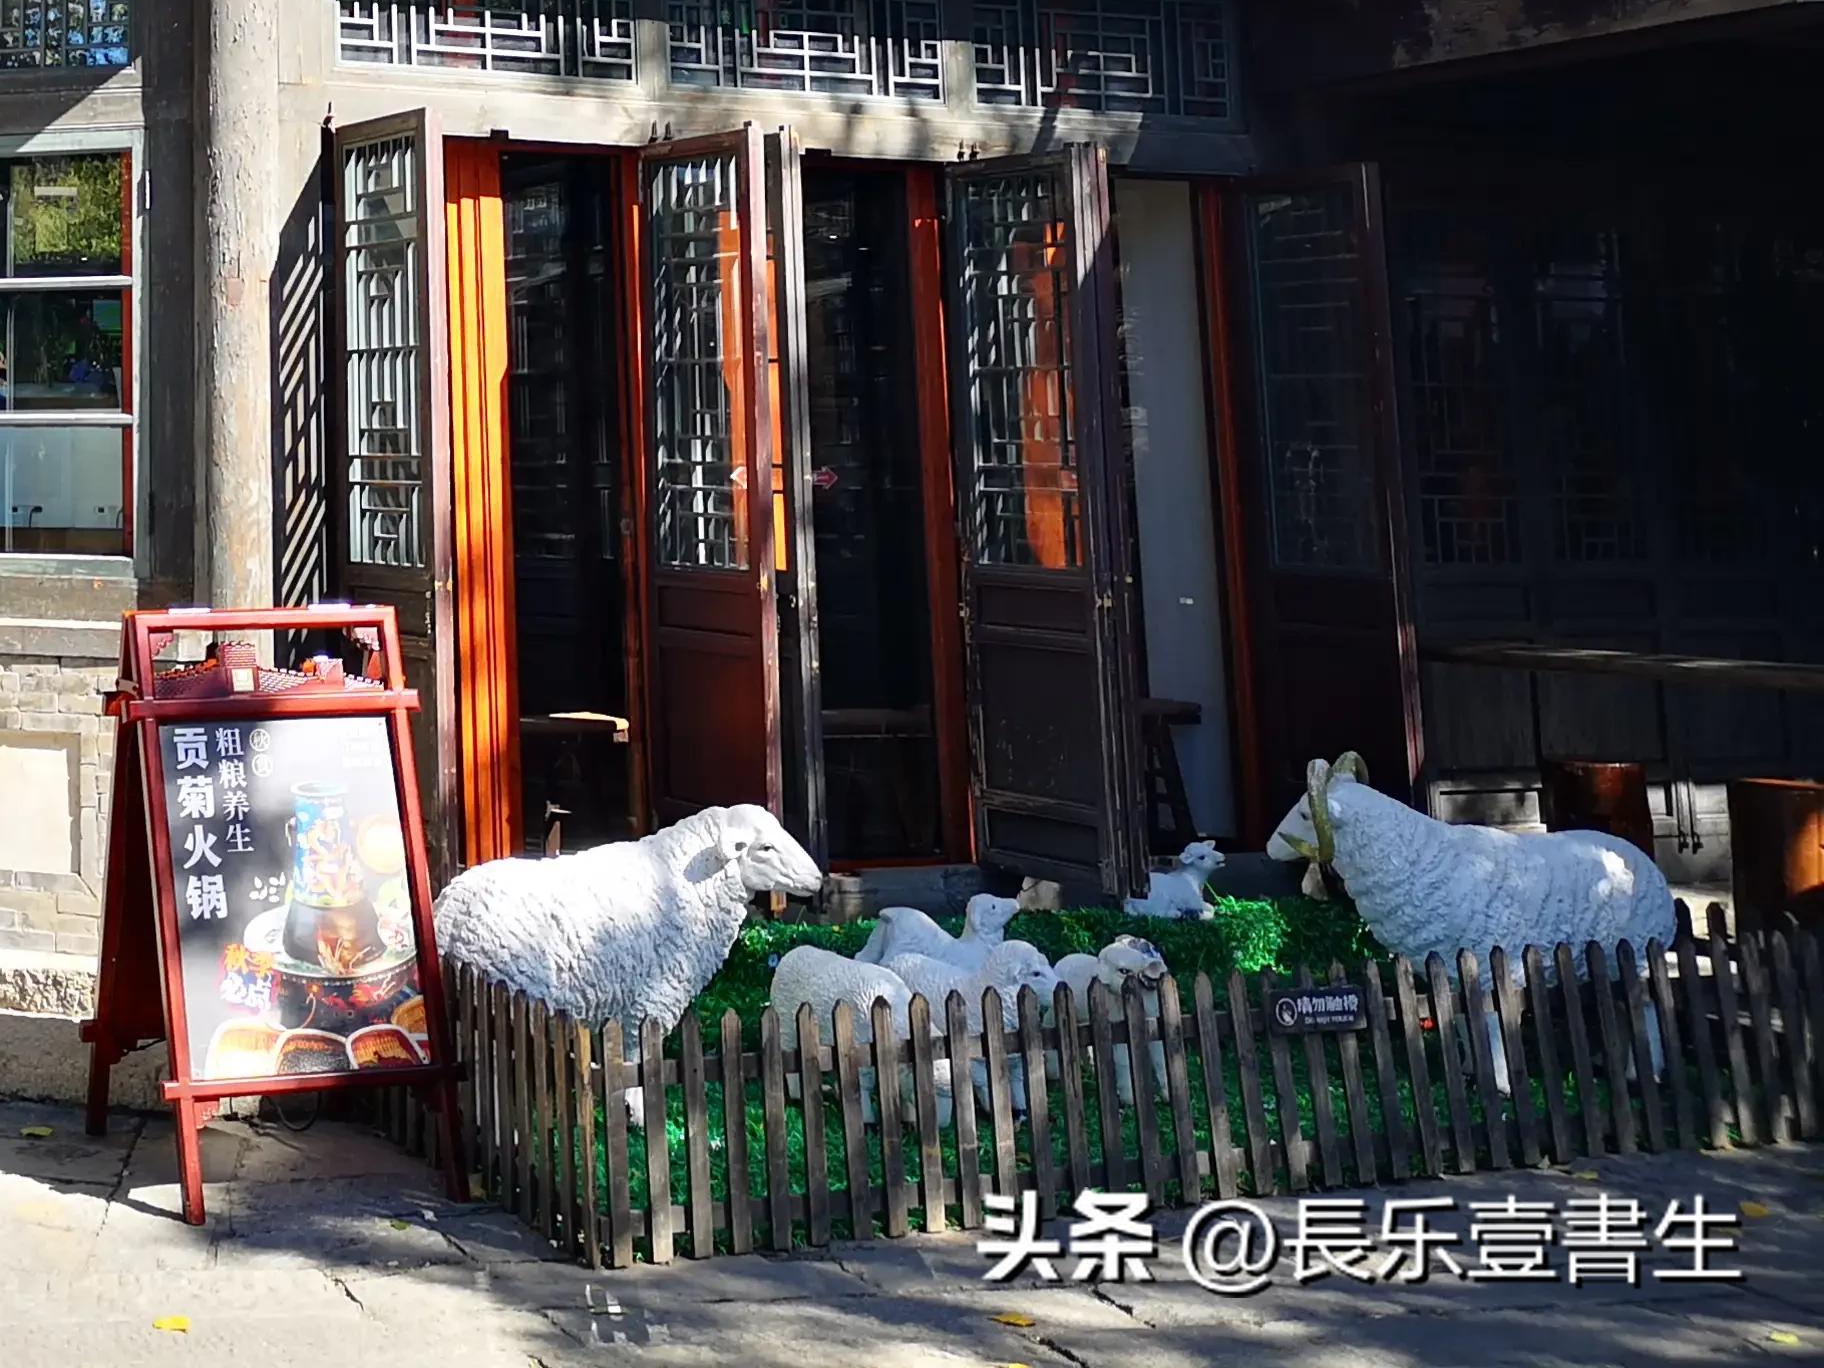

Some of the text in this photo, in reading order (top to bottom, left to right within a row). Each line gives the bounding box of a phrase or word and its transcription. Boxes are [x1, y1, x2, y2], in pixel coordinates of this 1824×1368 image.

[173, 727, 229, 921] 贡菊火锅
[215, 727, 254, 852] 粗粮养生
[1297, 994, 1358, 1014] 请勿触摸
